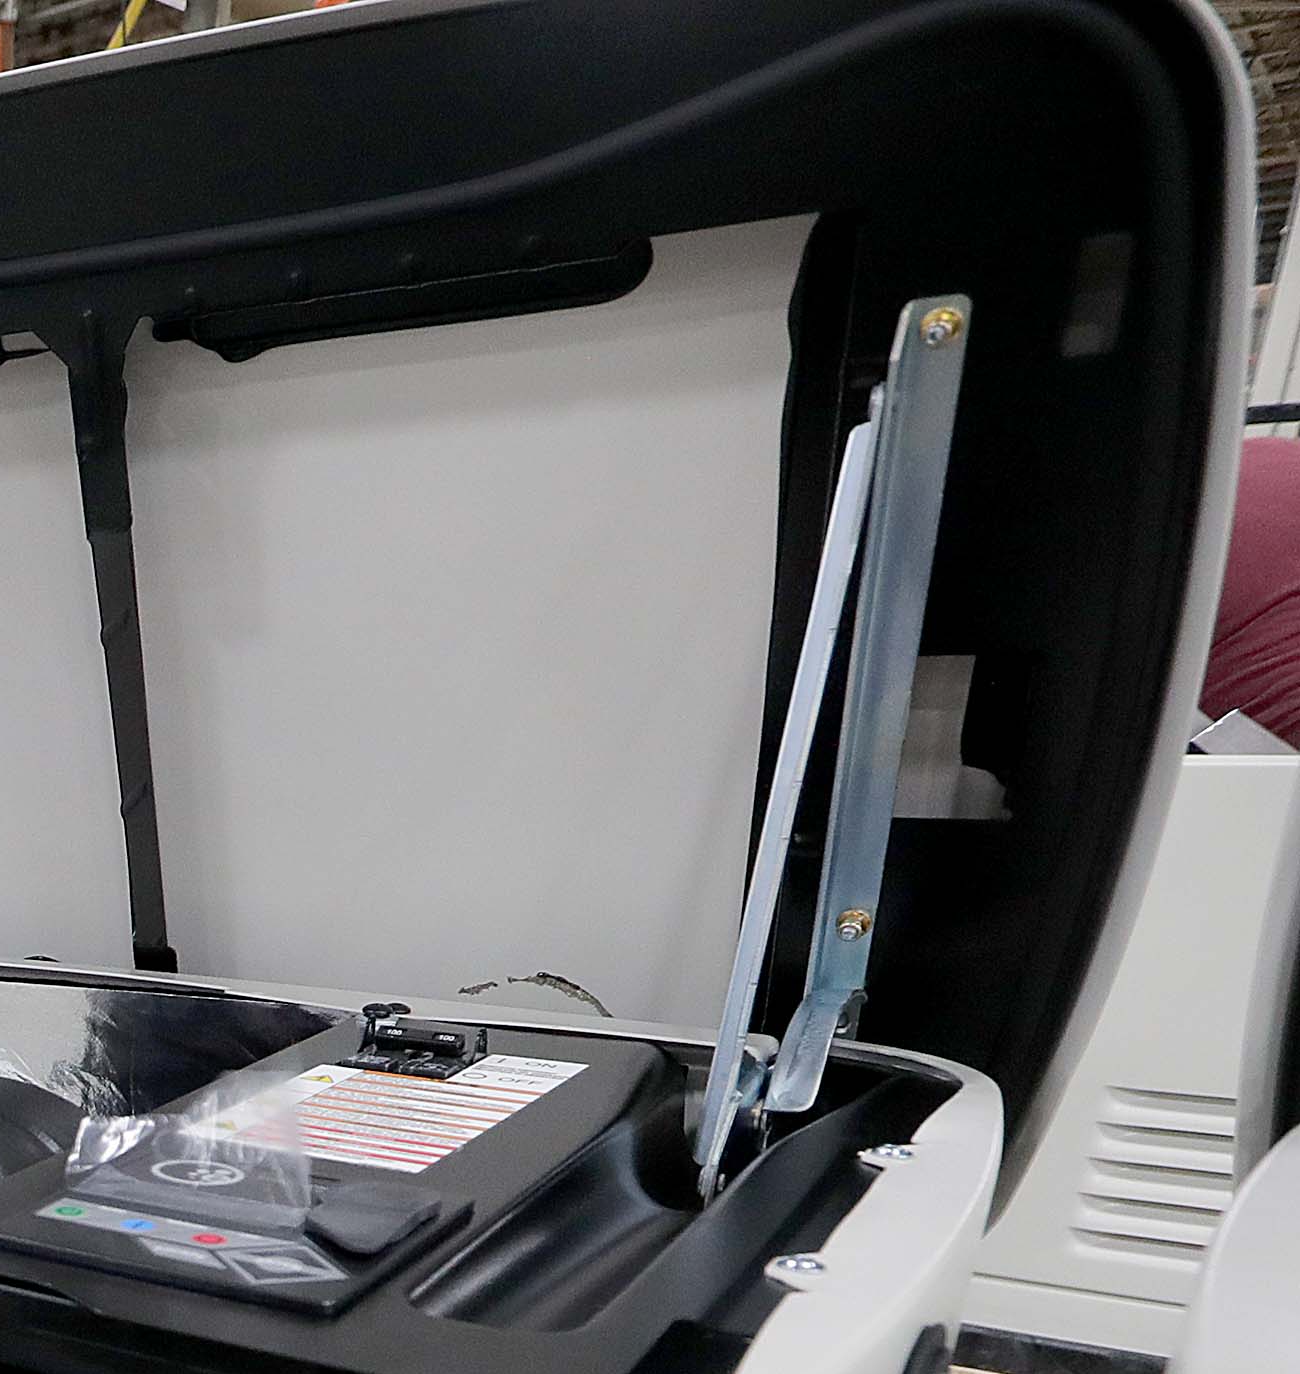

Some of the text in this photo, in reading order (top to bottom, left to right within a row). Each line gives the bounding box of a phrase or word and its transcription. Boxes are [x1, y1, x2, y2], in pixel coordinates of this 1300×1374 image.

[439, 1034, 456, 1042] 100
[525, 1061, 558, 1069] ON
[498, 1077, 545, 1085] OFF
